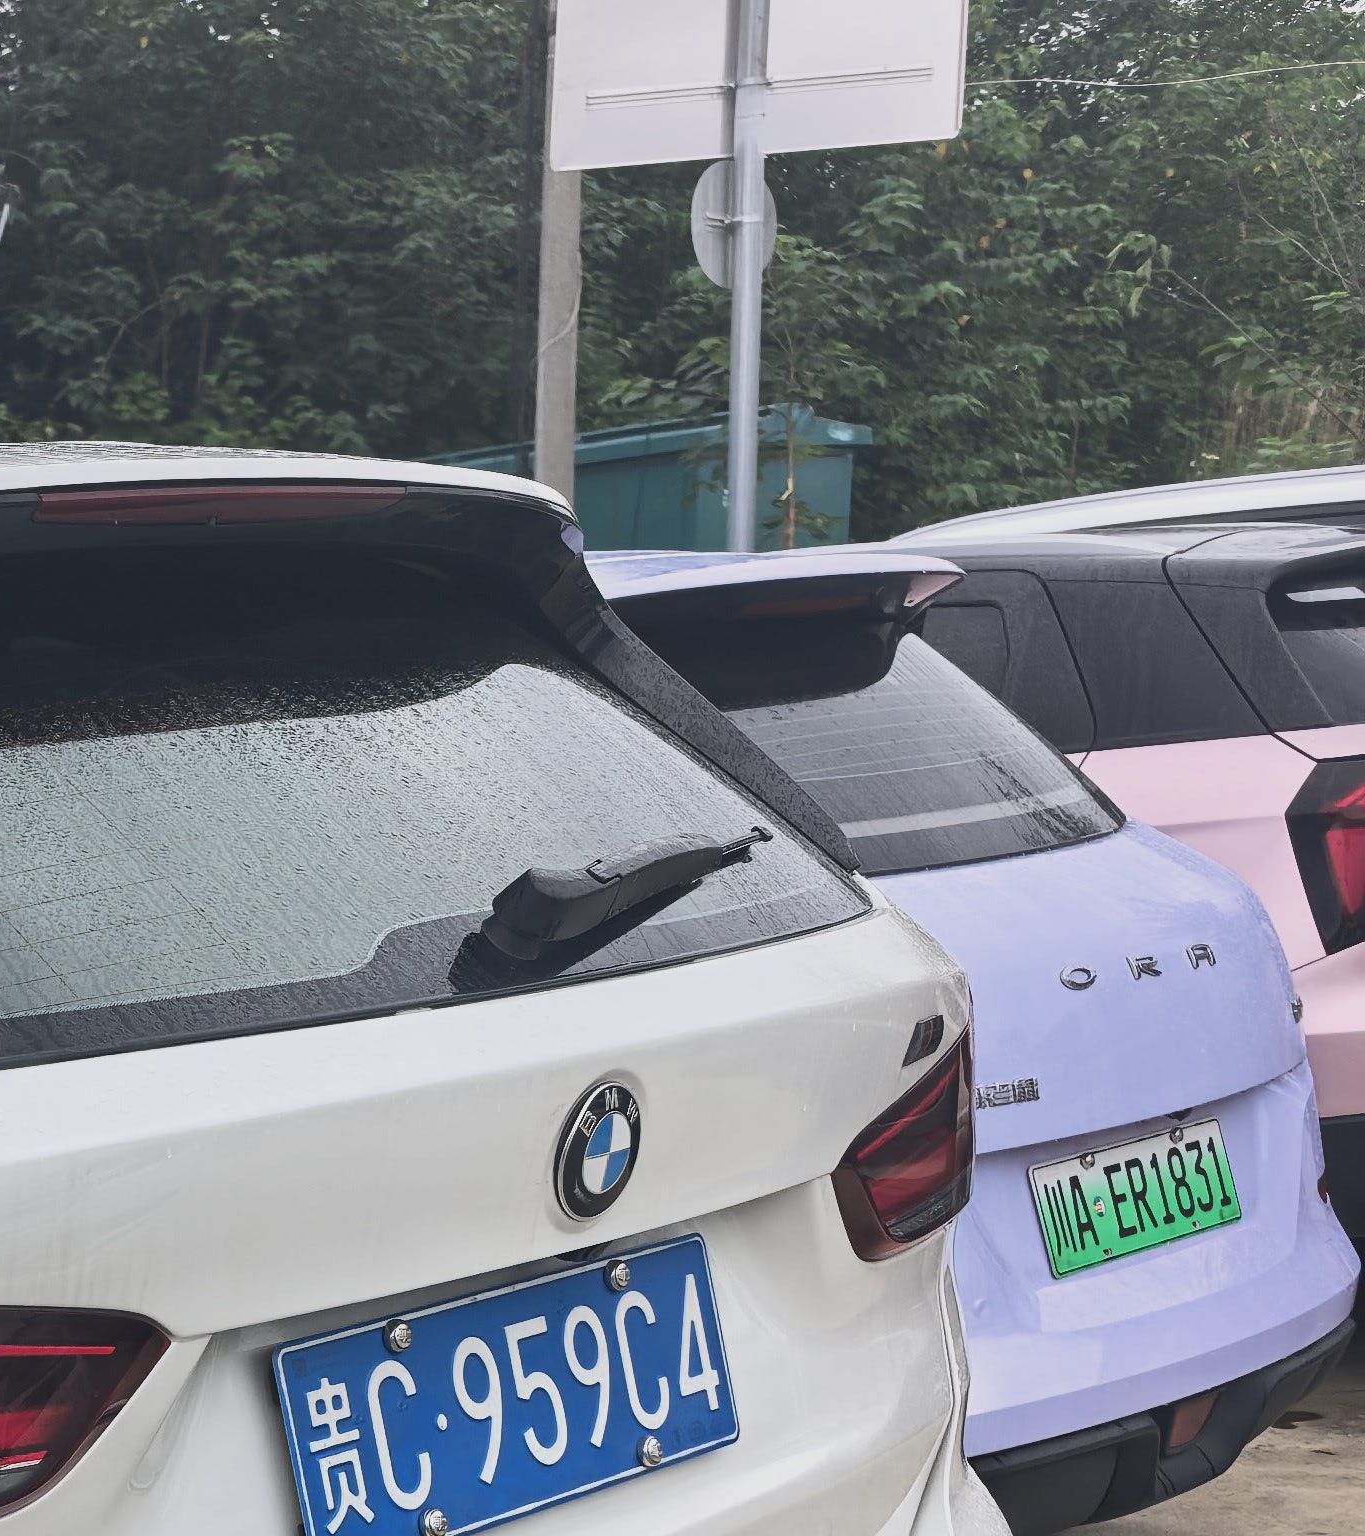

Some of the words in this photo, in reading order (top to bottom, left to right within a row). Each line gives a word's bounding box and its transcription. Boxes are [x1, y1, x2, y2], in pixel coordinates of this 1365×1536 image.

[1059, 943, 1217, 991] ORA
[580, 1087, 640, 1138] BMW
[305, 1273, 720, 1535] 贵C·959C4
